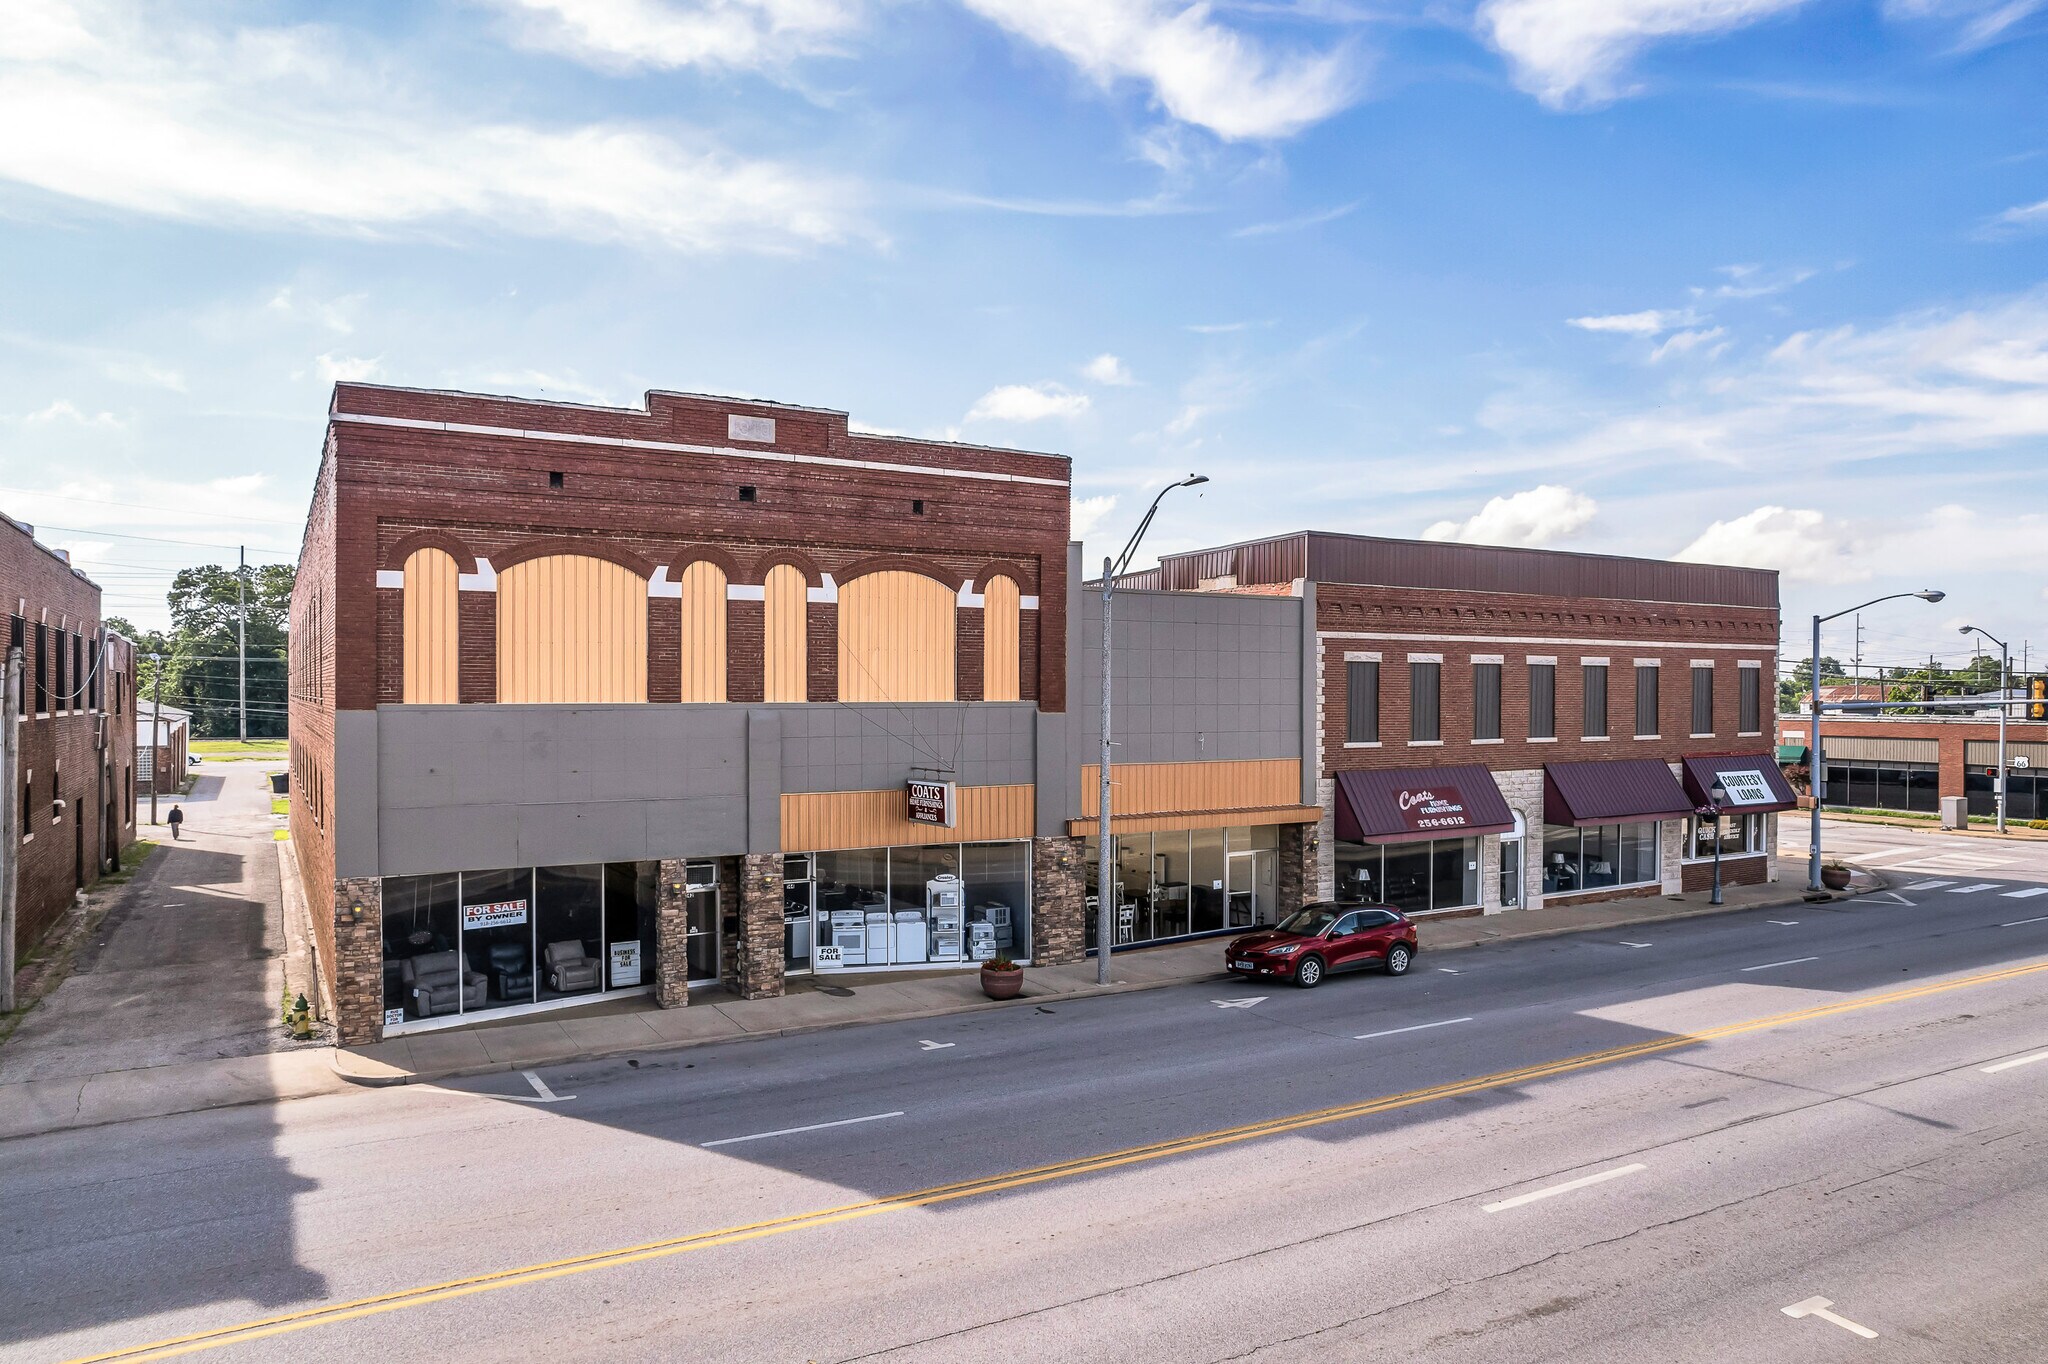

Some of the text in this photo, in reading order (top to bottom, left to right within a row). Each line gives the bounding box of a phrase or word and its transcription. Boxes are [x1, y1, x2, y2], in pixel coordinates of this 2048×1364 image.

[1722, 774, 1763, 787] COURTESY
[911, 784, 940, 799] COATS
[1736, 788, 1765, 800] LOANS
[1399, 790, 1434, 810] Coats
[1429, 799, 1449, 807] HOME
[1420, 805, 1462, 814] FURNISHINGS
[1417, 816, 1465, 828] 256-6612
[466, 901, 524, 916] FOR SALE
[485, 912, 523, 921] OWNER
